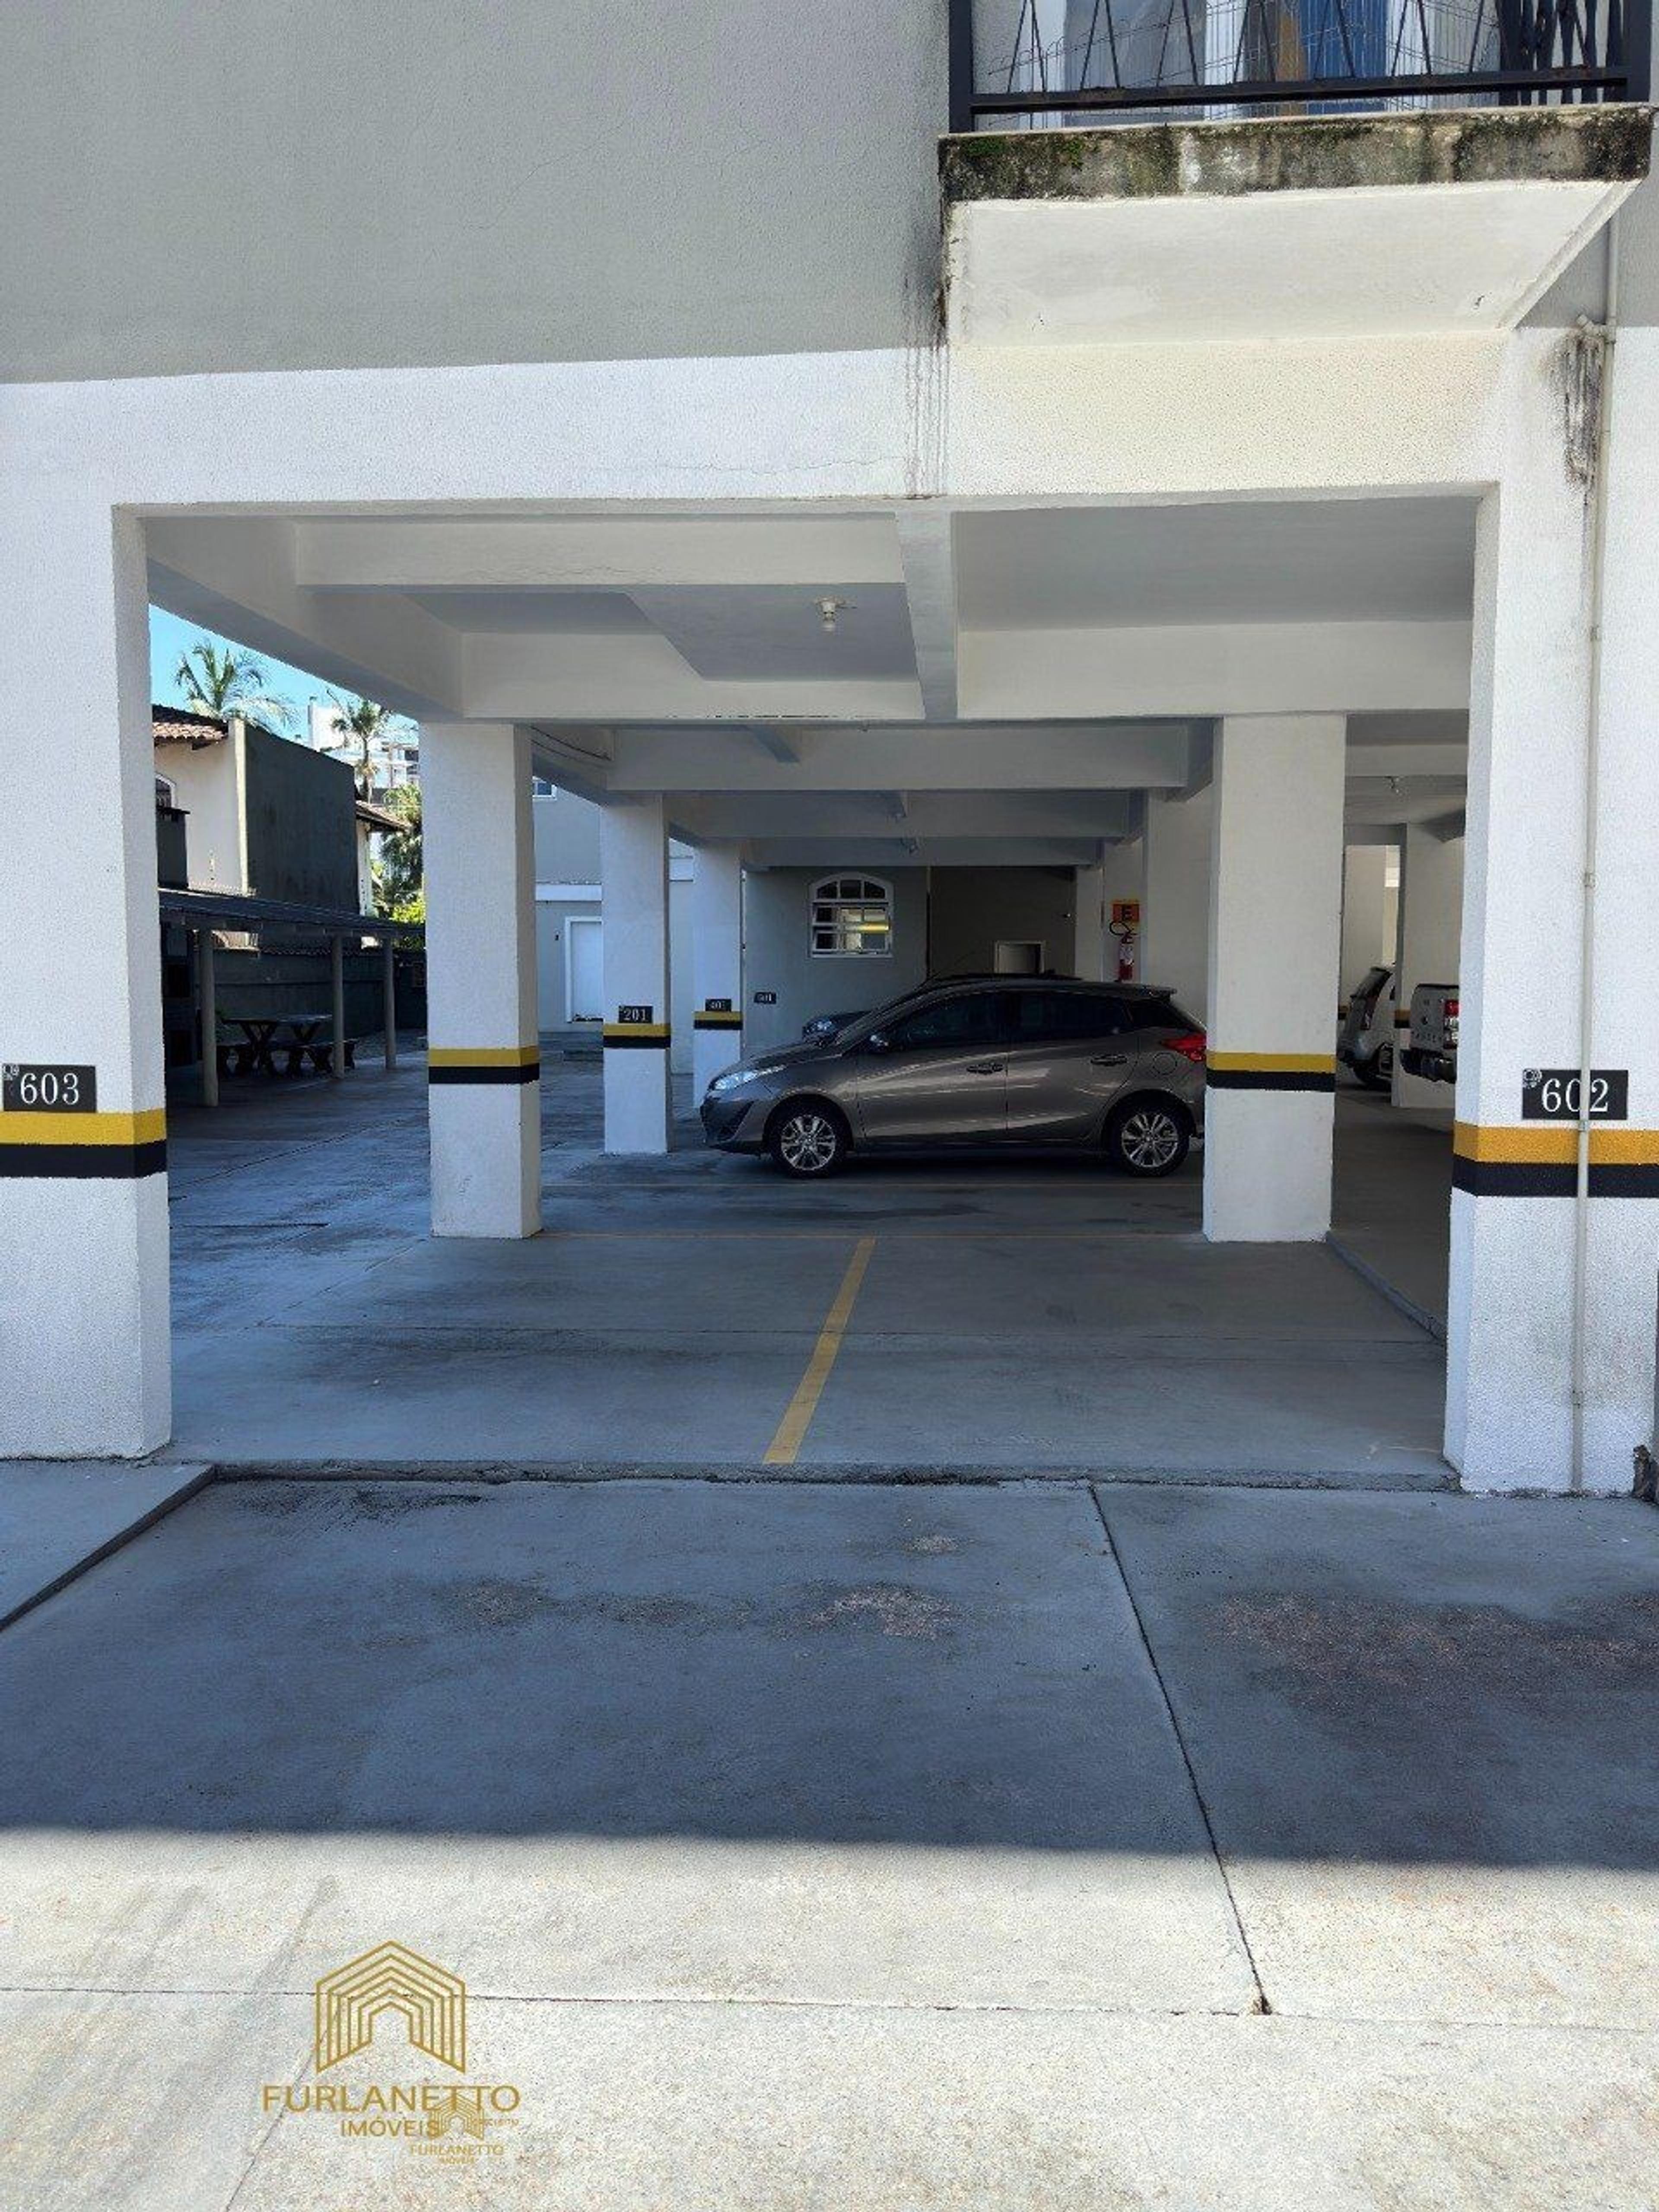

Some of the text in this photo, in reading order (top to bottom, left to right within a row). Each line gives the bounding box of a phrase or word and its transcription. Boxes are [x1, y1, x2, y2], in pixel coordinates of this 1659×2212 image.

[623, 1009, 646, 1021] 201
[21, 1073, 79, 1104] 603
[1541, 1078, 1609, 1112] 602
